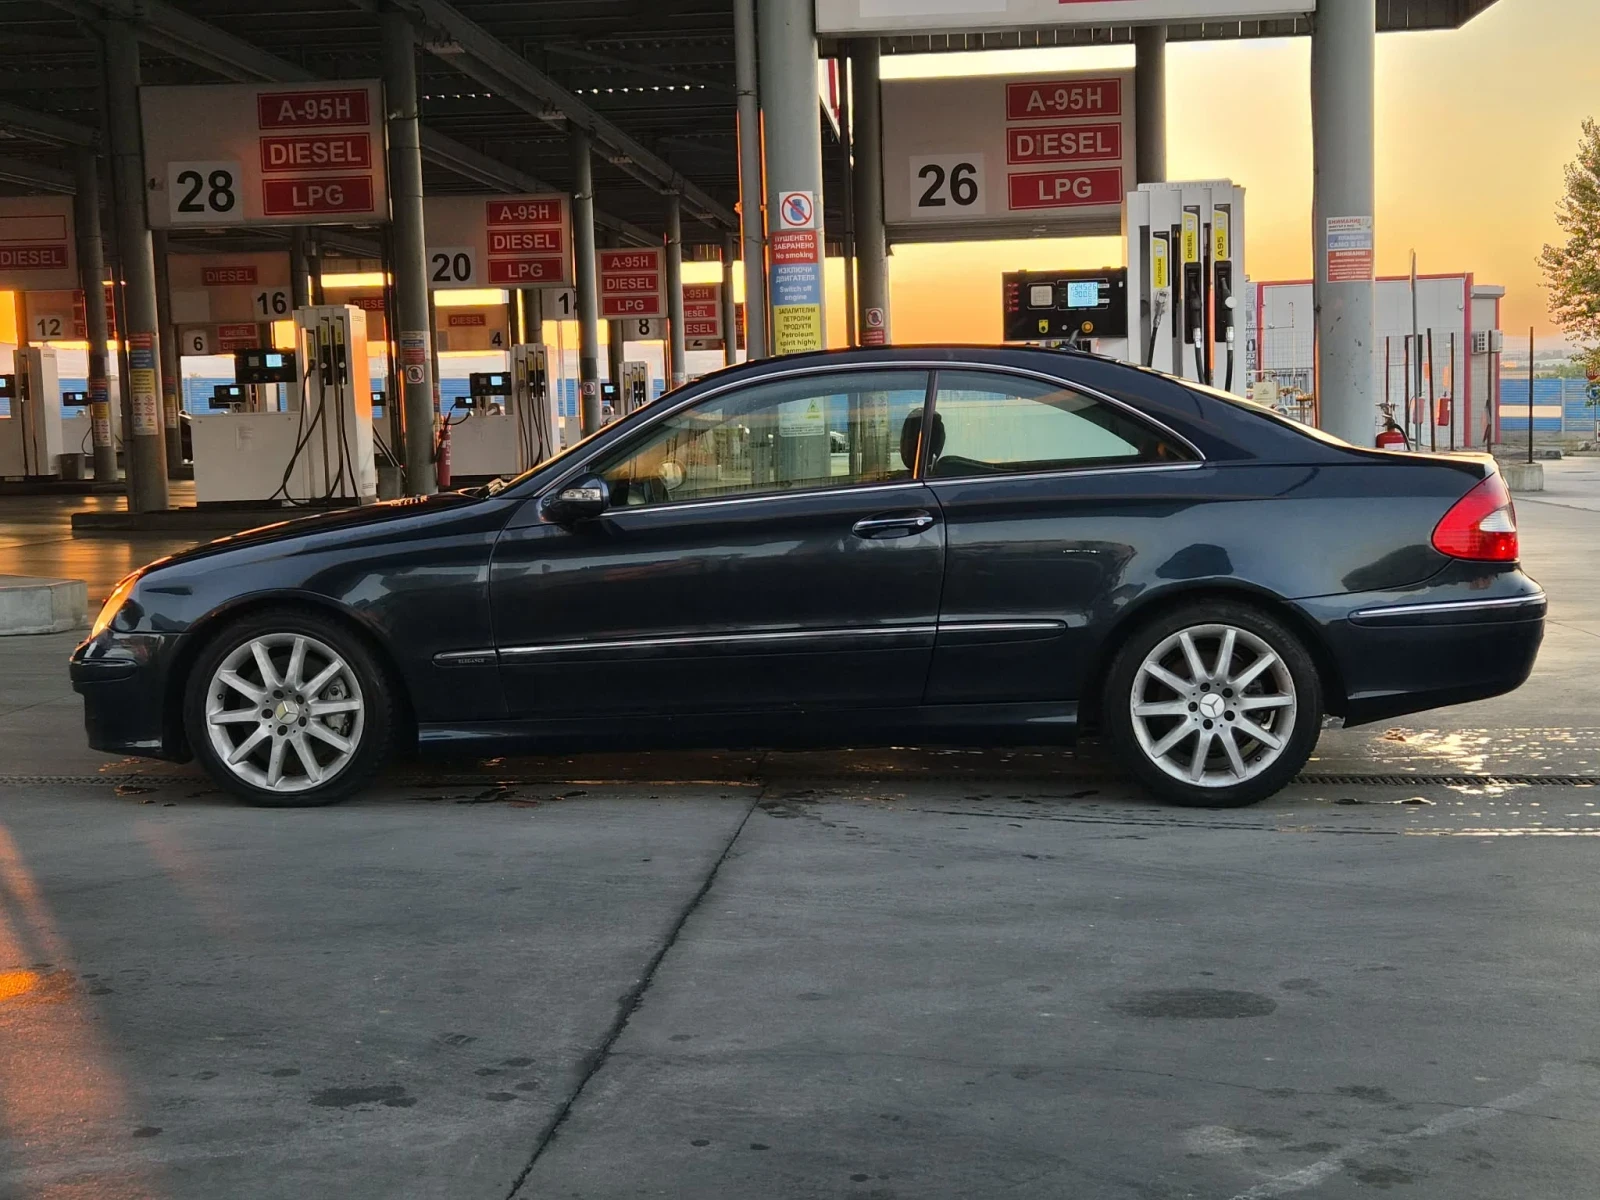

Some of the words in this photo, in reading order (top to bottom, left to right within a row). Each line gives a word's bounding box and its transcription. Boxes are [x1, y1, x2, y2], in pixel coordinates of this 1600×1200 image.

[1026, 87, 1102, 112] A-95H
[277, 98, 351, 121] A-95H
[1016, 132, 1112, 156] DIESEL
[270, 141, 361, 165] DIESEL
[176, 170, 235, 213] 28
[917, 162, 978, 208] 26
[1038, 177, 1092, 200] LPG
[292, 185, 344, 207] LPG
[500, 205, 549, 220] A-95H
[493, 234, 556, 249] DIESEL
[773, 242, 815, 251] ЗАБРАНЕНО
[0, 250, 62, 265] DIESEL
[611, 256, 649, 268] A-95H
[785, 251, 814, 260] smoking
[431, 253, 471, 282] 20
[508, 263, 543, 278] LPG
[206, 270, 253, 282] DIESEL
[606, 277, 654, 290] DIESEL
[775, 274, 815, 284] ДВИГАТЕЛЯ
[683, 288, 709, 299] -95H
[784, 294, 807, 302] engine
[257, 291, 287, 315] 16
[353, 299, 384, 309] DIESE
[617, 299, 645, 311] LPG
[37, 318, 61, 336] 12
[451, 316, 483, 324] DIESEL
[638, 318, 650, 335] 8
[686, 323, 714, 334] ESEL
[193, 336, 203, 351] 6
[491, 331, 503, 347] 4
